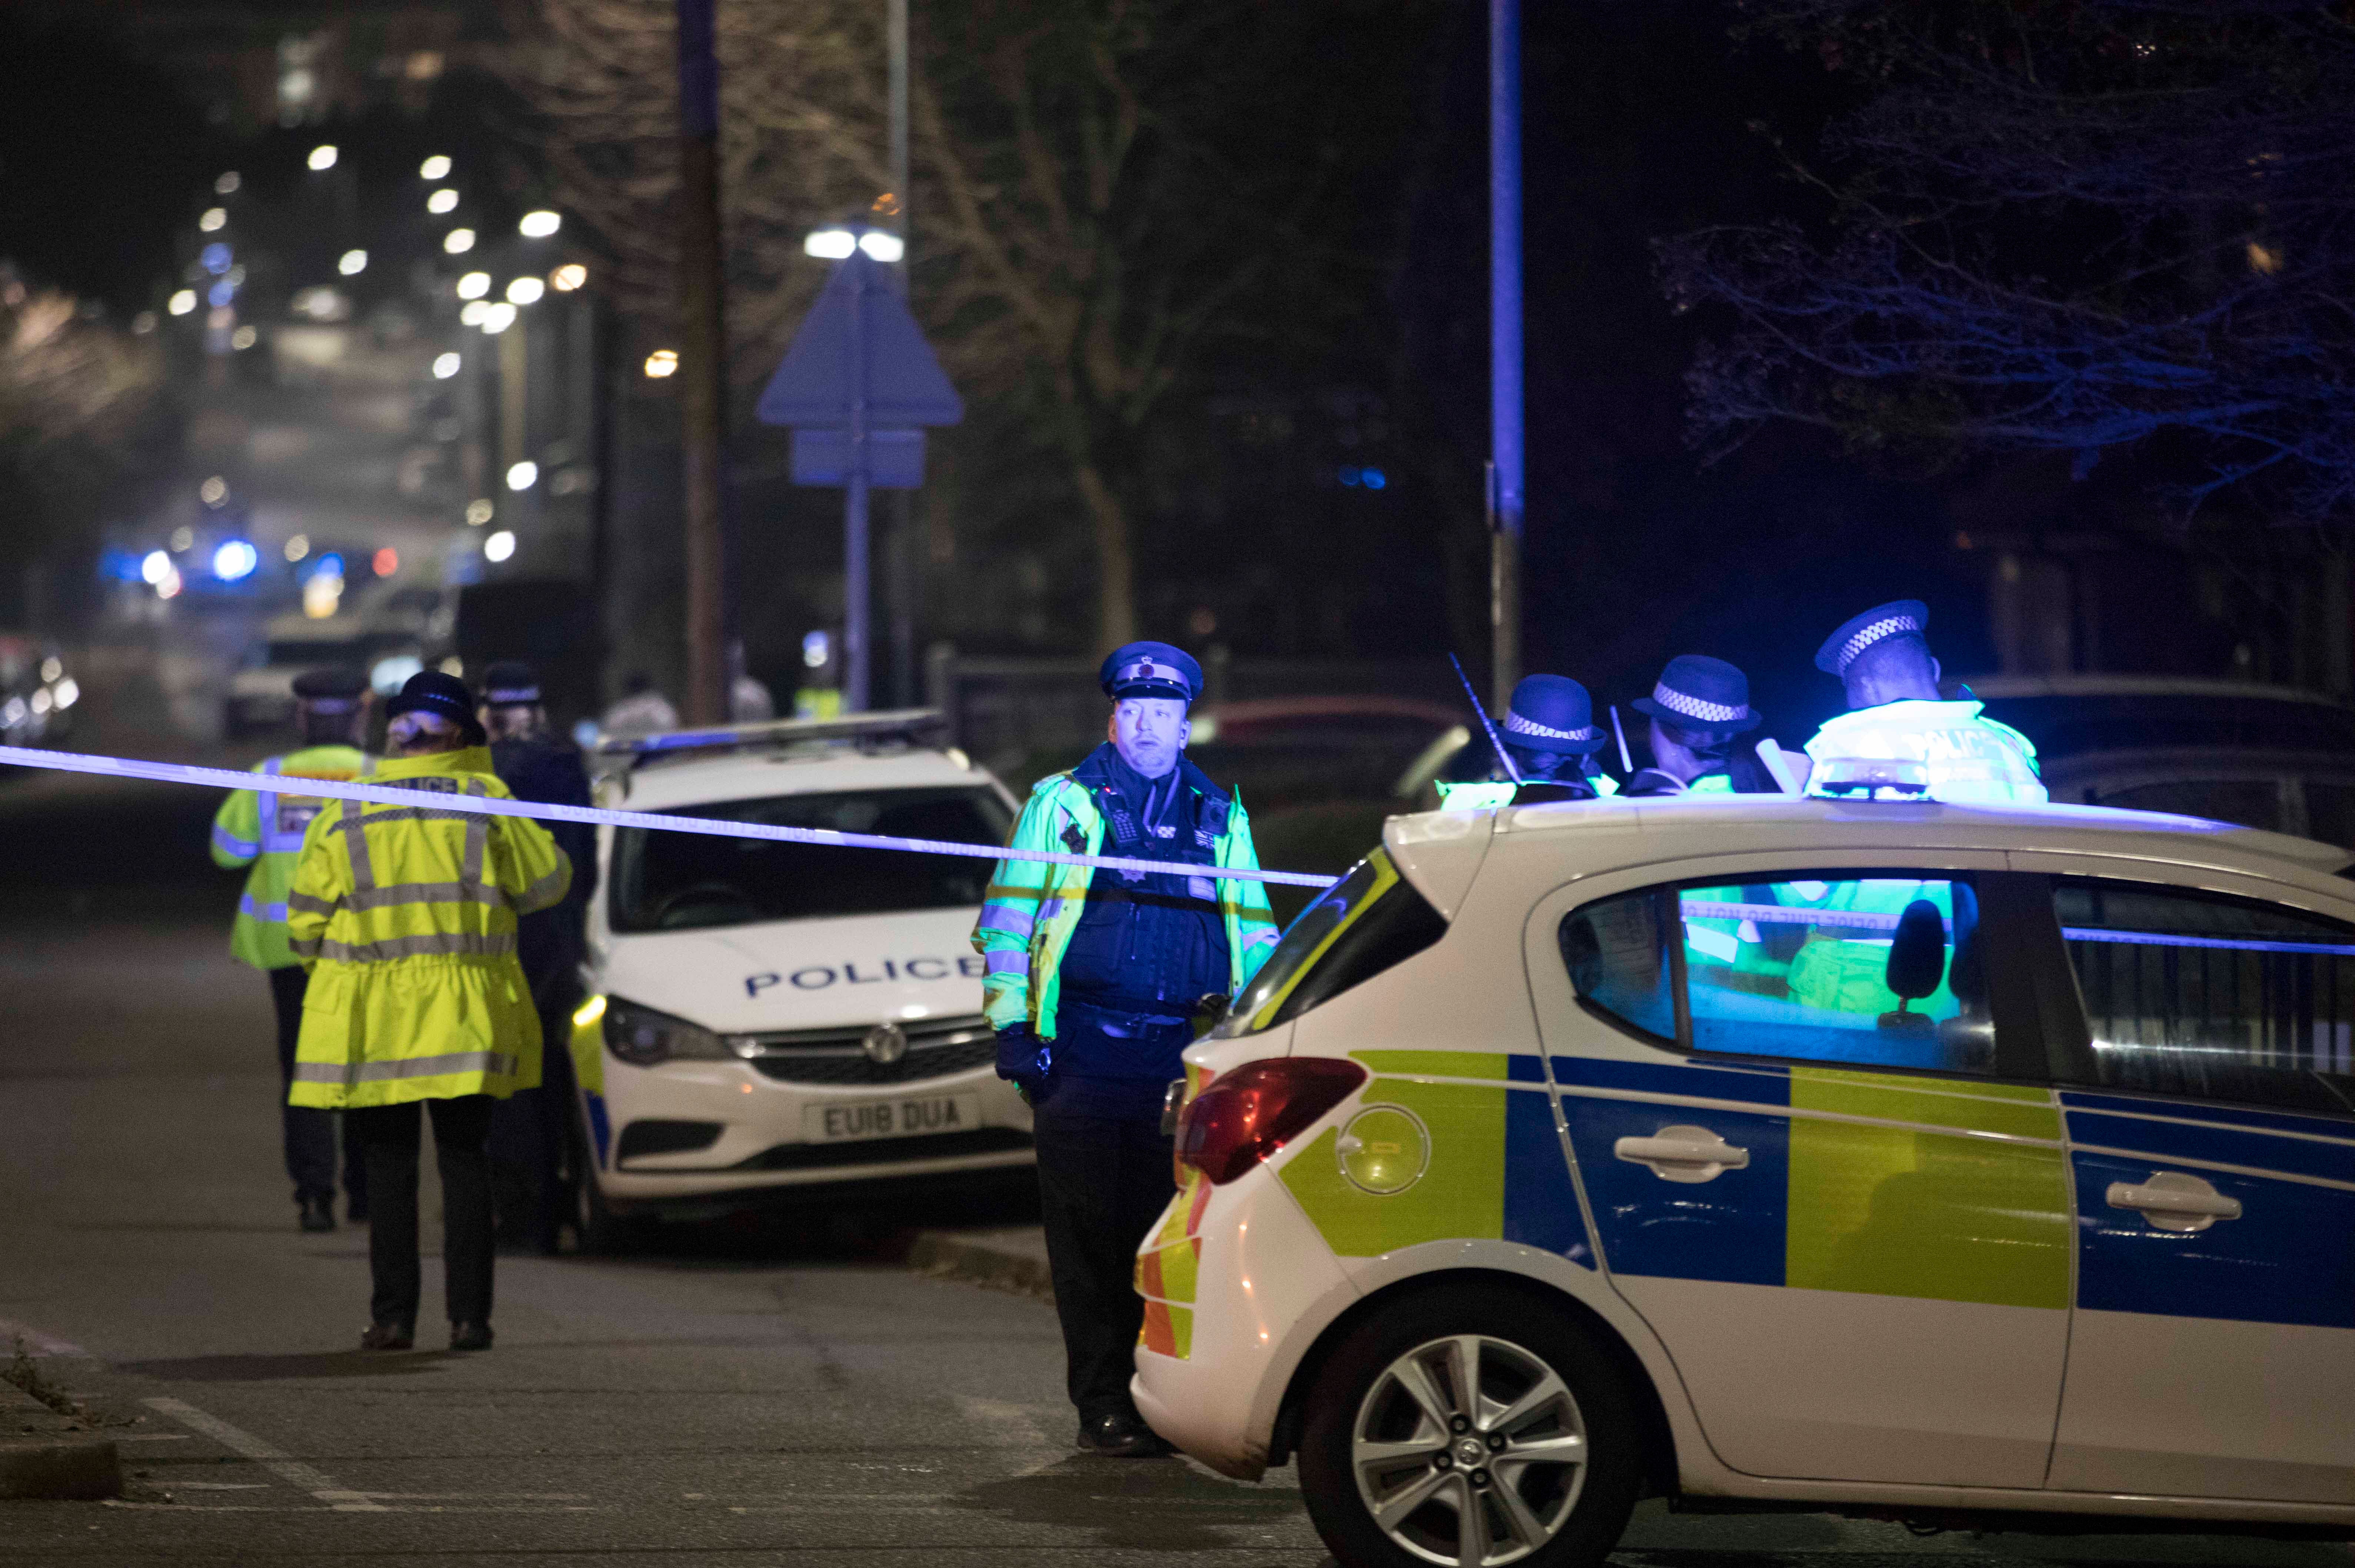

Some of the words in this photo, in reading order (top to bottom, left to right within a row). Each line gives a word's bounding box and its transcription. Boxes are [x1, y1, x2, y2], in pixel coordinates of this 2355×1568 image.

[745, 955, 985, 998] POLICE
[824, 1104, 892, 1135] EU18
[902, 1098, 960, 1130] DUA
